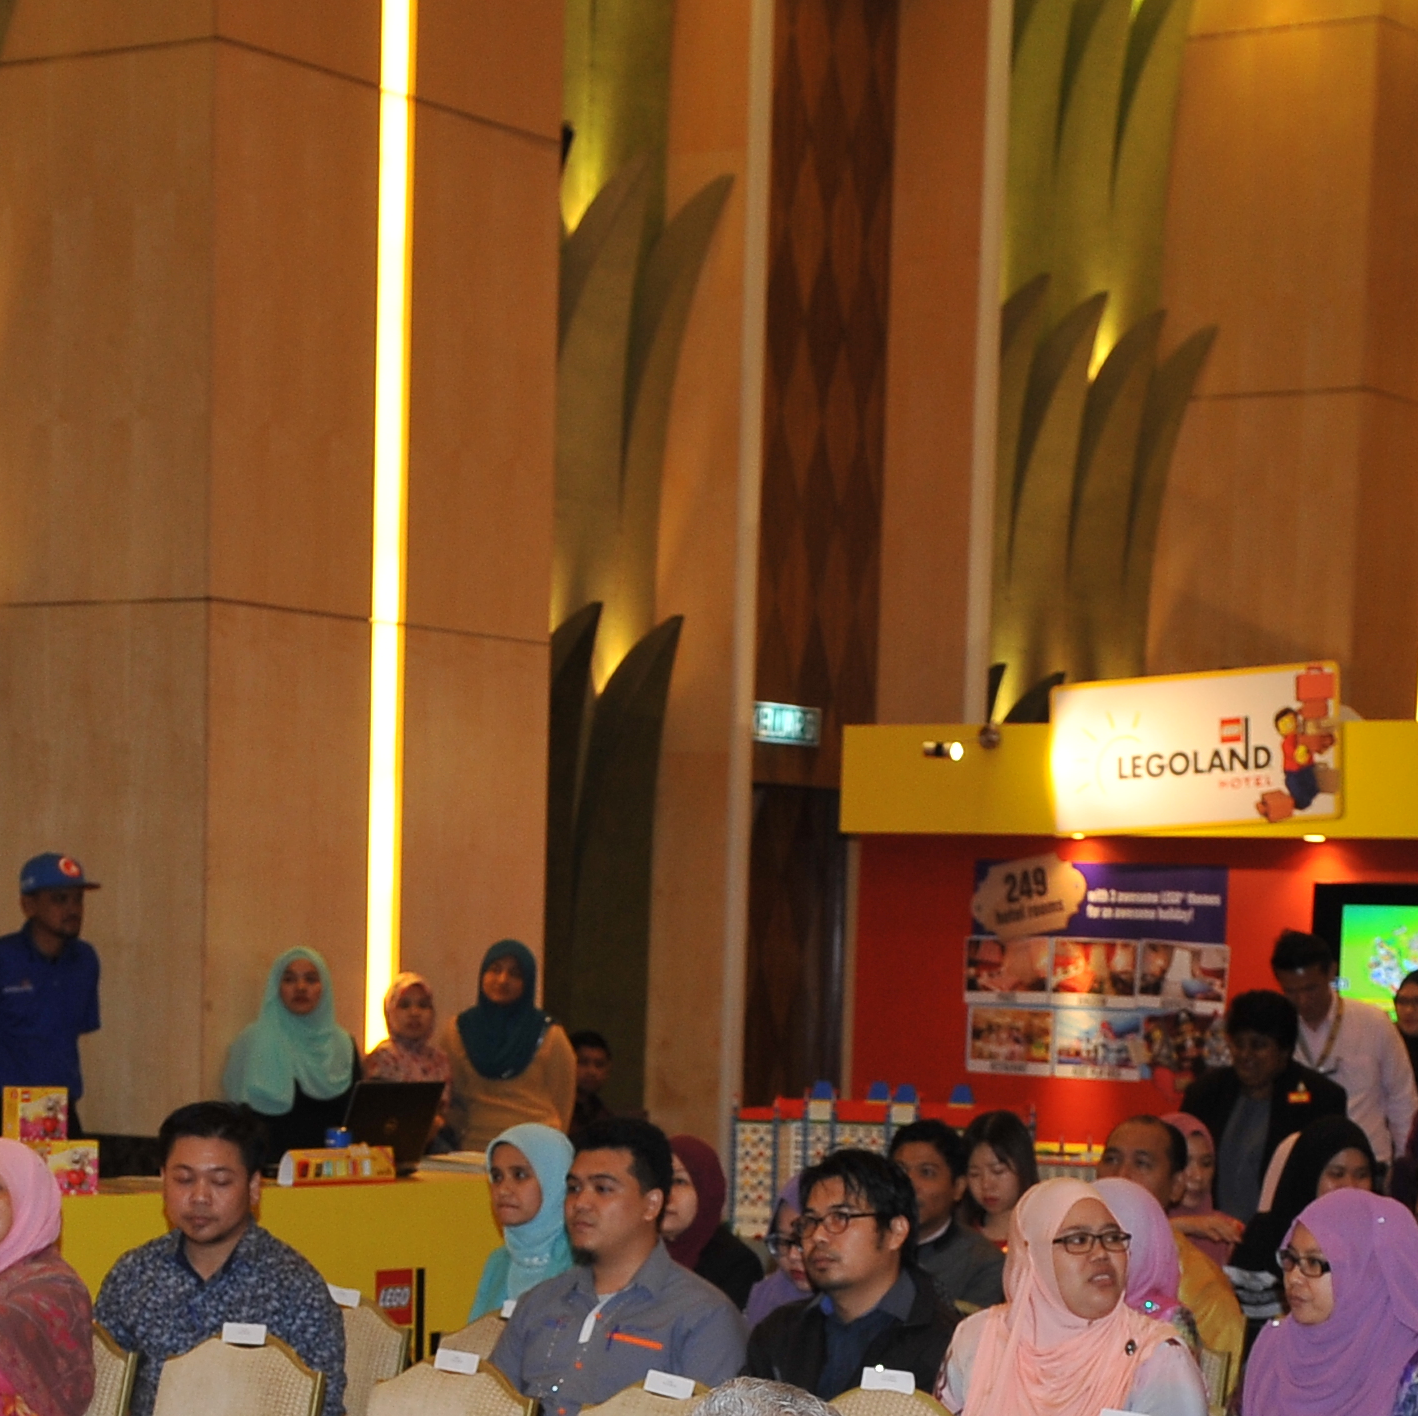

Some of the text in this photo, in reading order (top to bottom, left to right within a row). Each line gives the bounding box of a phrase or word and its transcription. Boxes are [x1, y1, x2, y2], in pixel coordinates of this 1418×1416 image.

[1118, 716, 1272, 780] LEGOLAND
[1219, 777, 1273, 790] HOTEL
[1004, 867, 1048, 902] 249
[379, 1285, 412, 1309] LEGO
